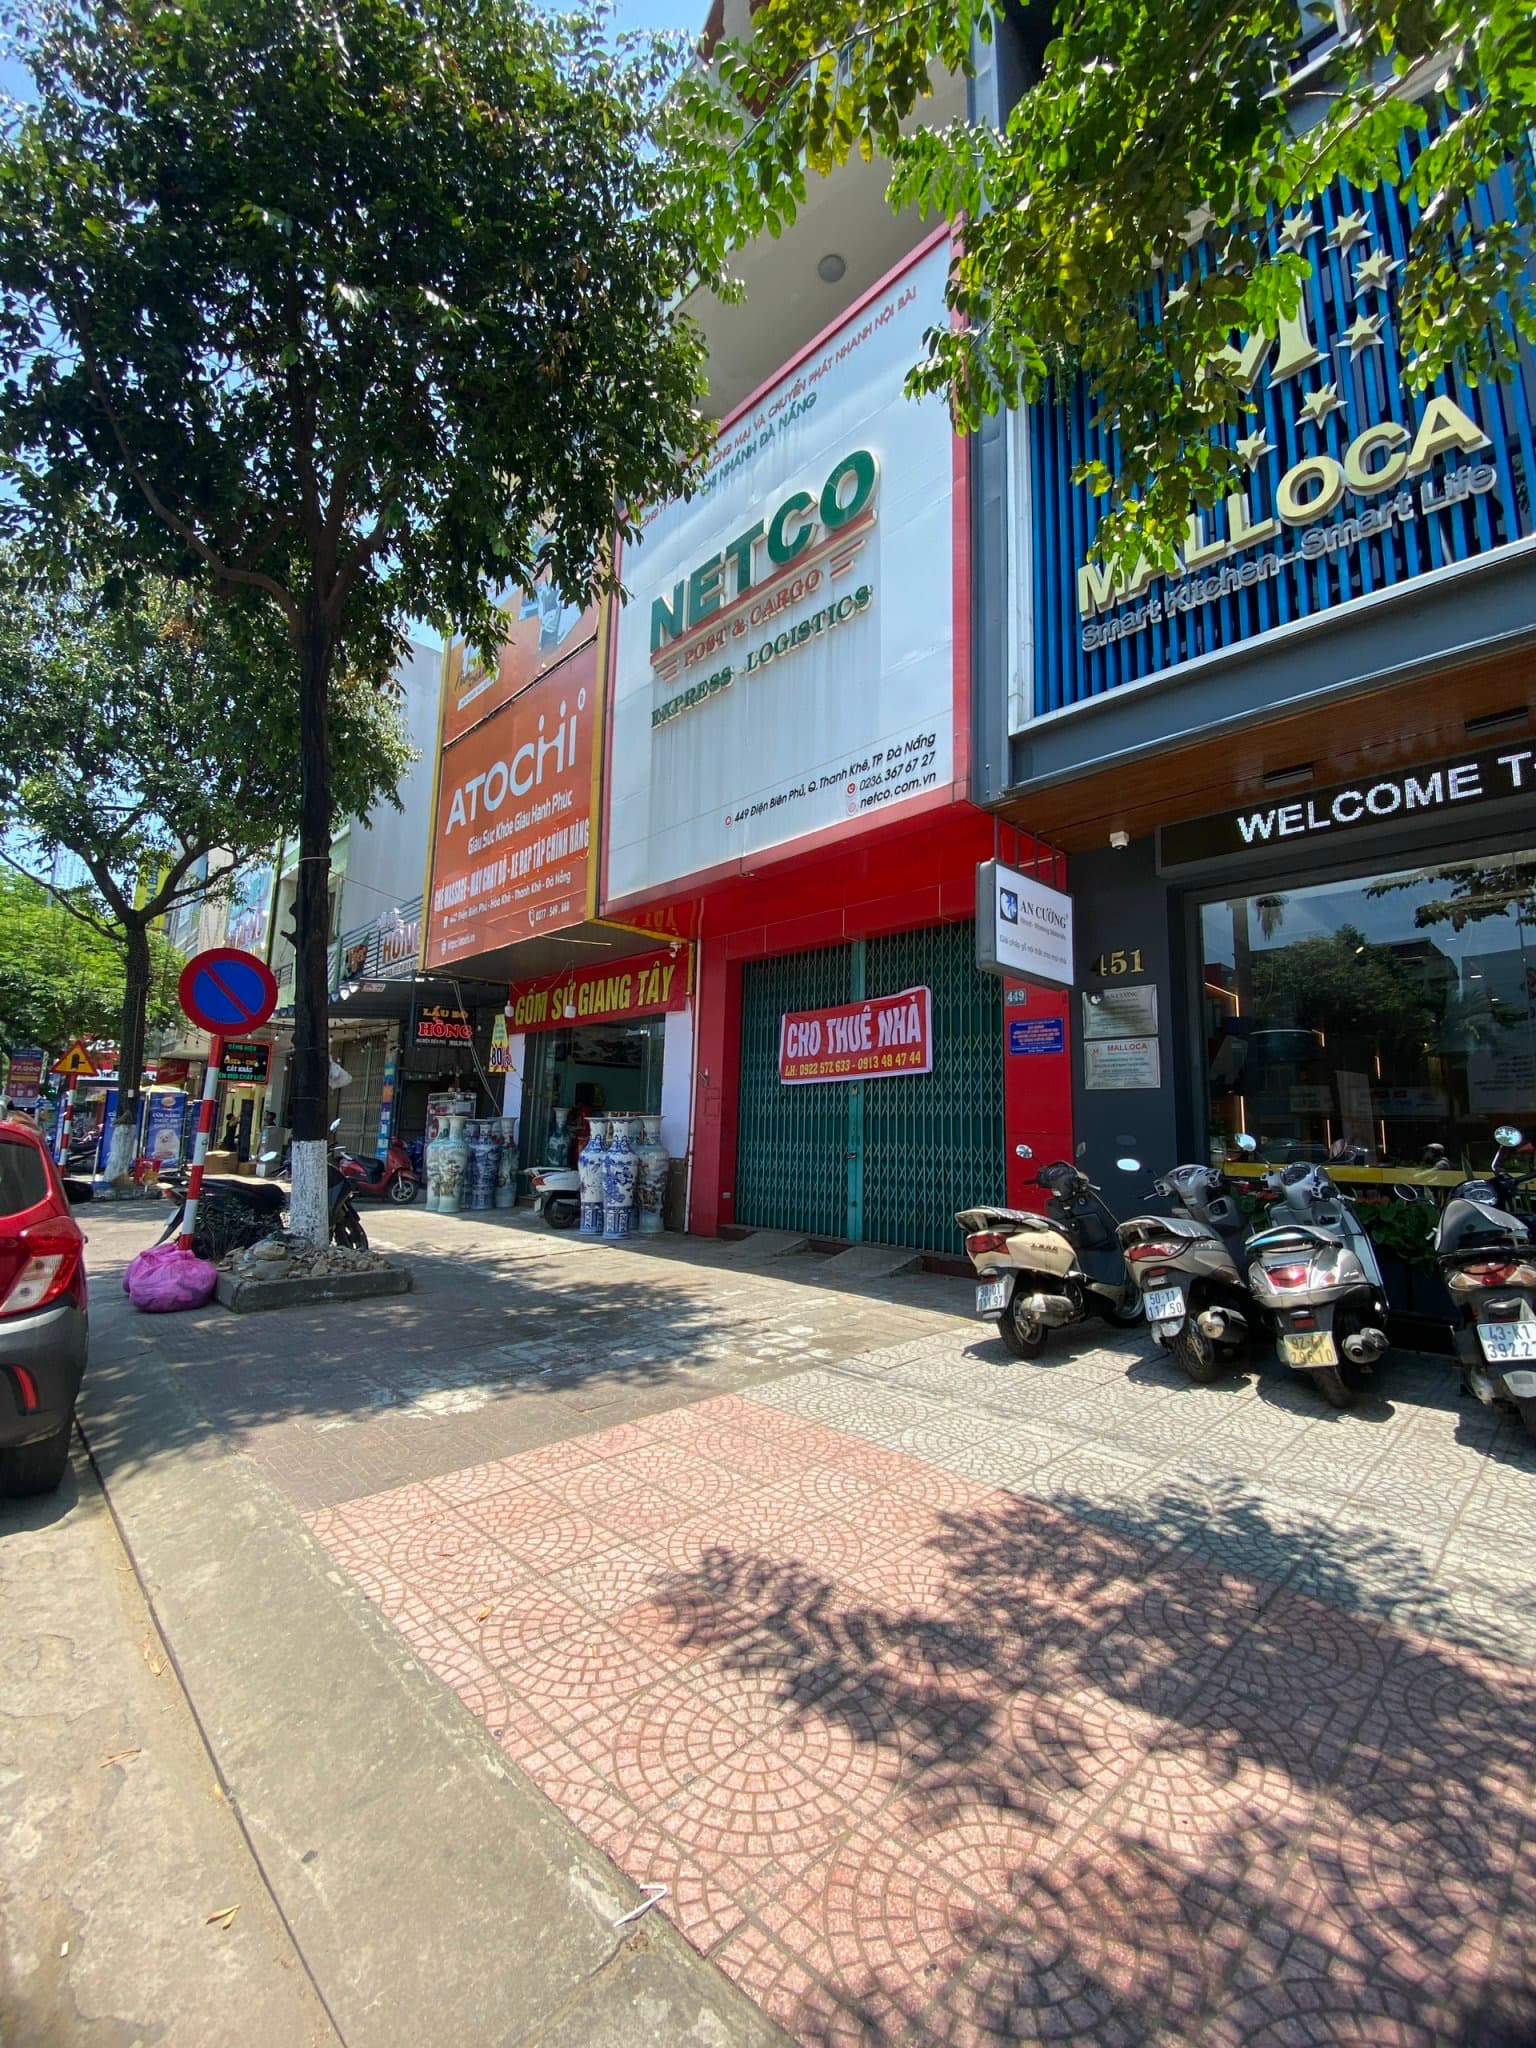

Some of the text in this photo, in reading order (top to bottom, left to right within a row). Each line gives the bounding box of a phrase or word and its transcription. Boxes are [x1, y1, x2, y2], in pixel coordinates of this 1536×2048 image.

[808, 357, 832, 386] PHÁT
[836, 322, 872, 363] NHANH
[720, 440, 757, 482] NHÁNH
[760, 423, 775, 449] ĐÀ
[651, 449, 879, 652] NETCO
[1081, 600, 1161, 652] Smart
[1164, 553, 1281, 618] Kitchen
[1300, 490, 1414, 561] Smart
[1420, 464, 1497, 516] Life
[684, 568, 824, 668] POST & CARGO
[651, 664, 735, 729] EXPRESS
[746, 584, 873, 674] LOGISTICS
[734, 808, 749, 822] 449
[750, 802, 769, 817] Điện
[769, 793, 788, 809] Biên
[849, 759, 870, 777] Khê,
[886, 744, 902, 762] Đà
[905, 757, 919, 774] 67
[920, 751, 936, 768] 27
[1237, 751, 1536, 844] WELCOME T
[1020, 901, 1067, 928] AN CƯỜNG
[515, 983, 548, 1026] GỐM
[578, 974, 632, 1016] GIANG
[637, 960, 675, 1006] TÂY
[1091, 949, 1144, 977] 451
[786, 995, 922, 1058] CHO THUÊ NHÀ
[1007, 990, 1025, 1002] 449
[418, 1016, 473, 1039] HỒNG
[1107, 1042, 1148, 1052] MALLOCA
[799, 1063, 818, 1076] 0922
[819, 1061, 835, 1075] 572
[835, 1060, 851, 1073] 633
[857, 1056, 879, 1070] 0913
[895, 1052, 907, 1066] 47
[909, 1051, 921, 1065] 44
[1488, 1324, 1531, 1341] 43-K1
